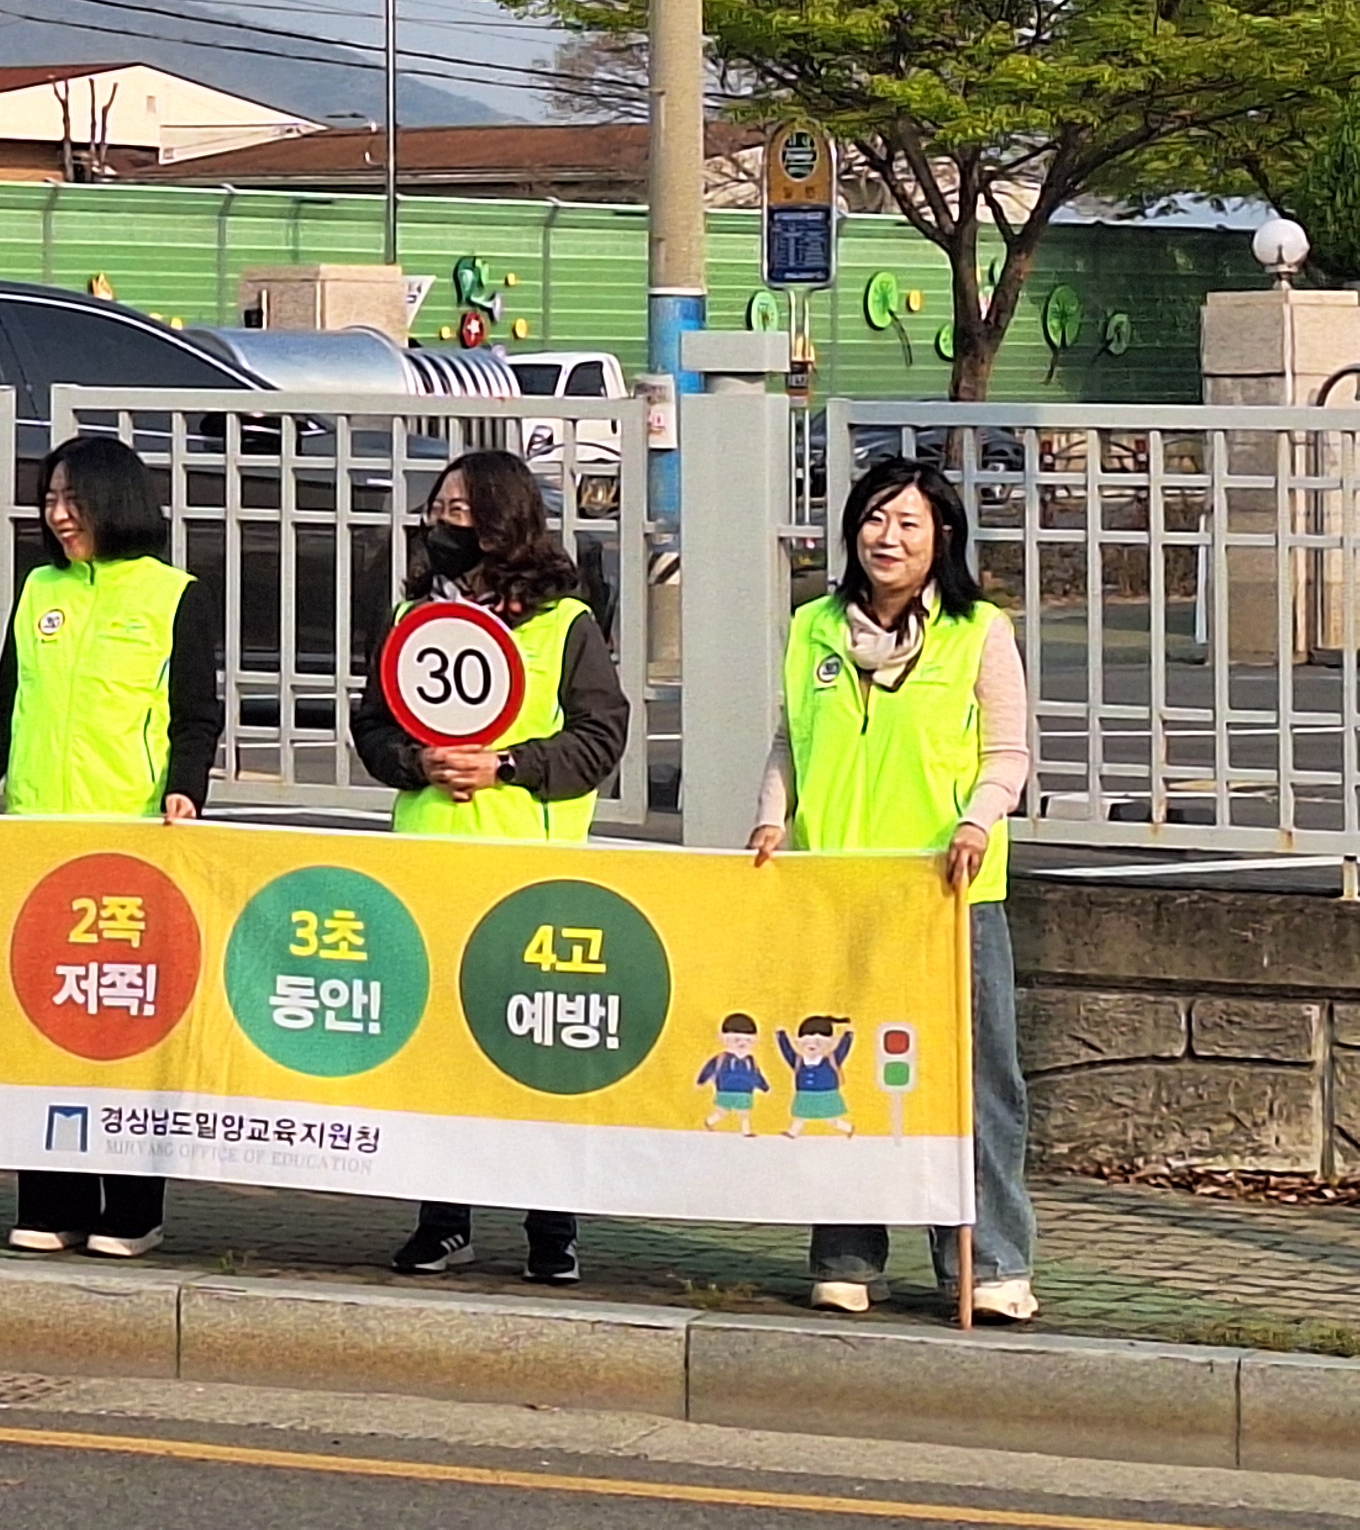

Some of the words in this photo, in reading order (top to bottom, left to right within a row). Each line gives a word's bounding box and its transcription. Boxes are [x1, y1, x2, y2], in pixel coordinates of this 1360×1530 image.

[416, 646, 493, 706] 30
[68, 895, 146, 948] 2쪽
[288, 909, 368, 962] 3초
[523, 924, 607, 974] 4고
[52, 962, 158, 1017] 저쪽!
[269, 974, 381, 1035] 동안!
[505, 990, 621, 1051] 예방!
[100, 1106, 381, 1154] 경상남도밀양교육지원청
[181, 1143, 240, 1164] OFFICE
[244, 1149, 267, 1166] OF
